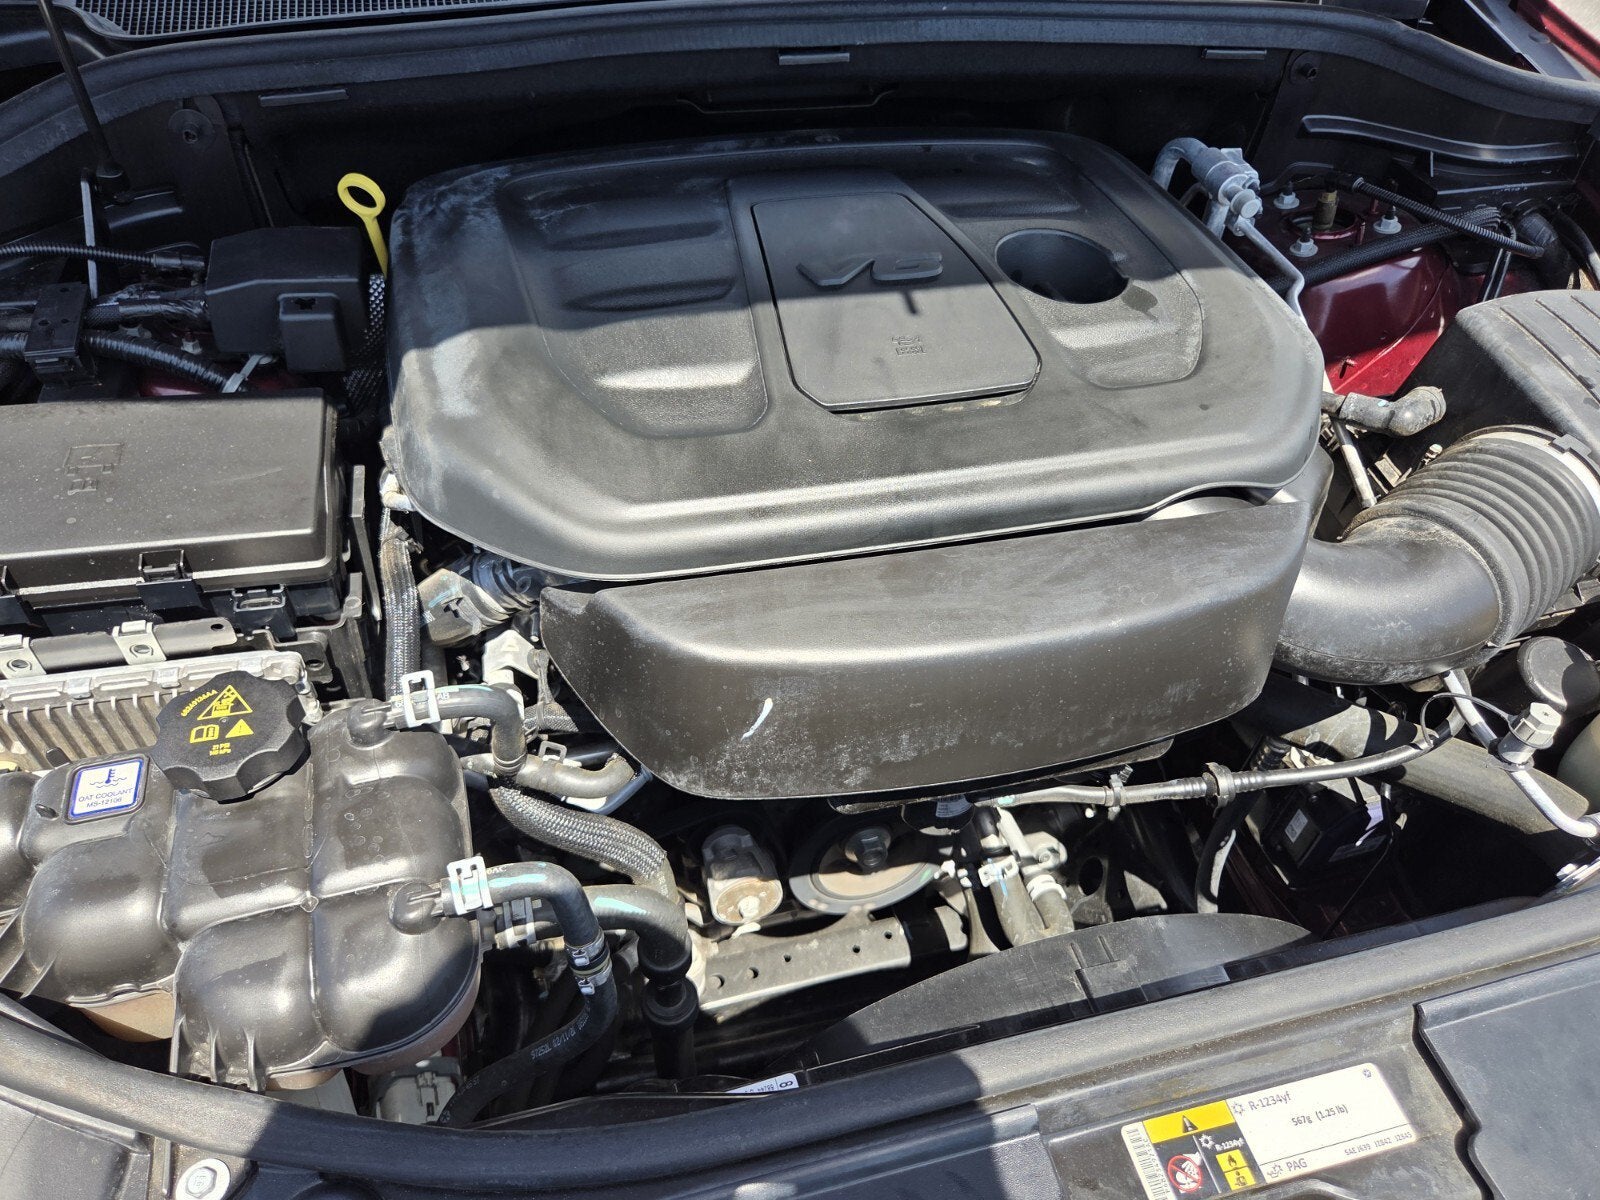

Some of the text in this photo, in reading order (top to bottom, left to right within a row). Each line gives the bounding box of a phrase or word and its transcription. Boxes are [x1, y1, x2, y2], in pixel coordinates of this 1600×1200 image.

[78, 787, 134, 803] OAT COOLANT
[1248, 1090, 1292, 1111] R-1234yf
[1291, 1104, 1349, 1126] 567g (1.25 lb)
[1285, 1157, 1308, 1172] PAG
